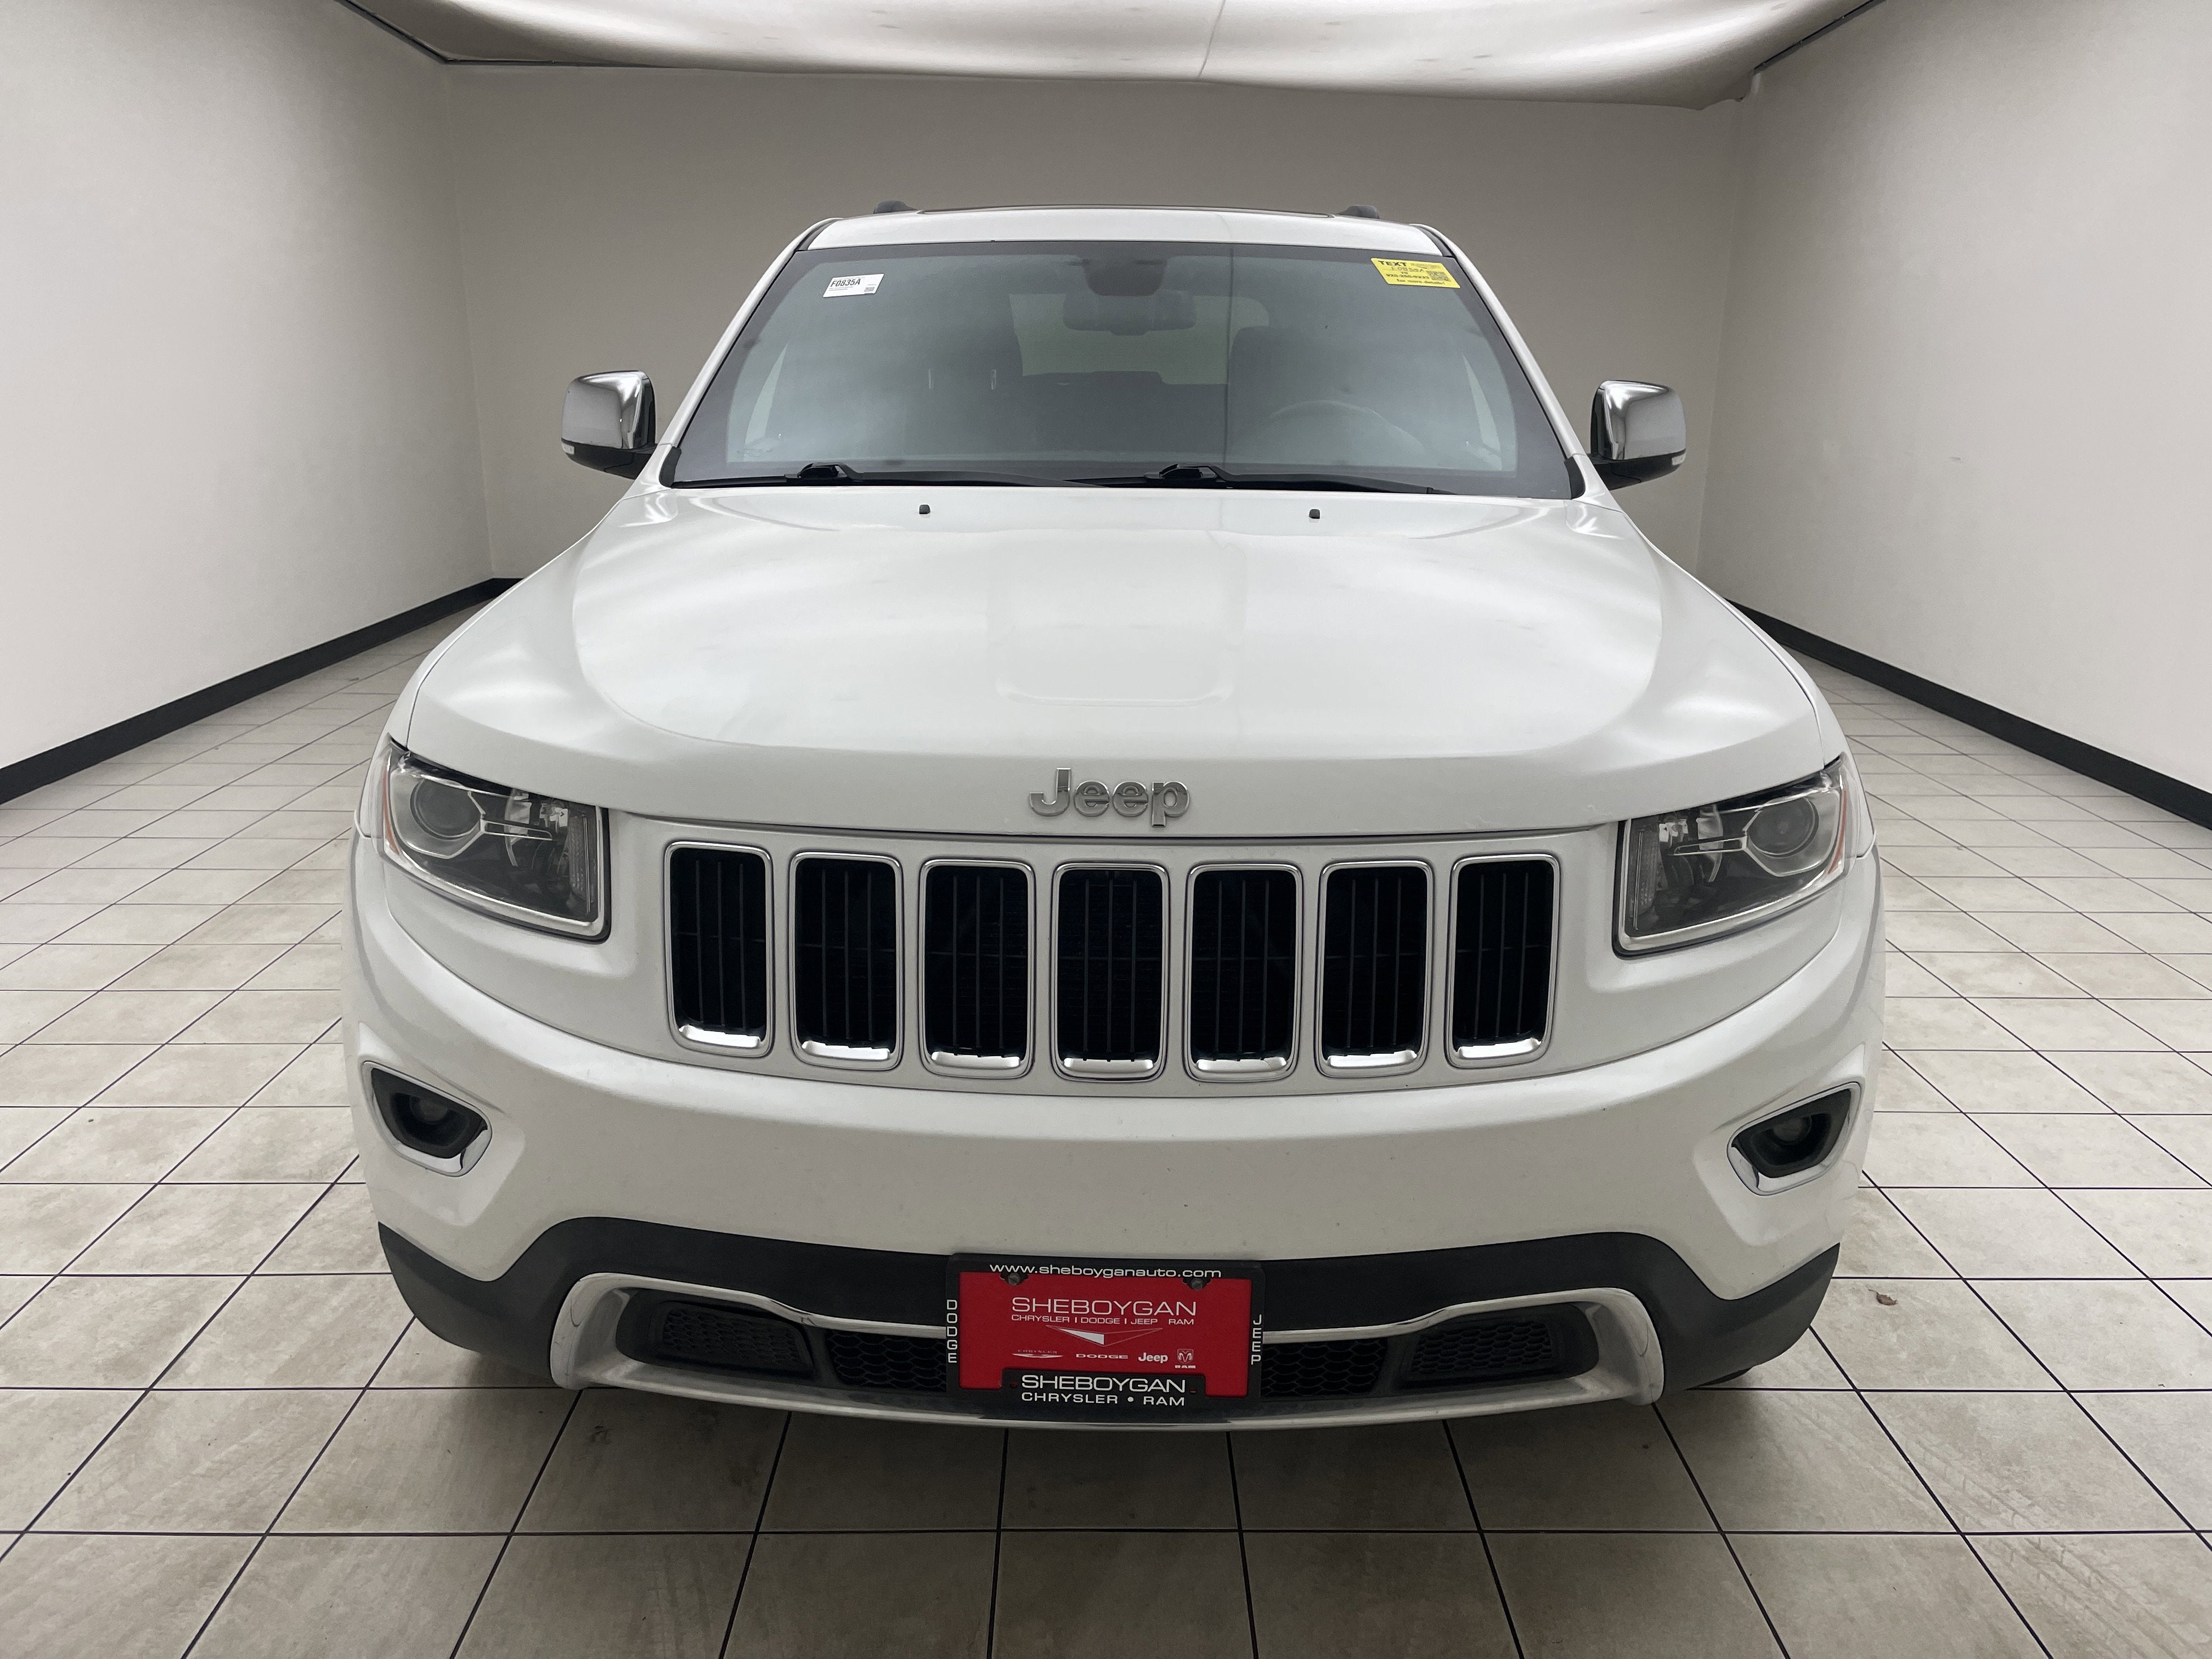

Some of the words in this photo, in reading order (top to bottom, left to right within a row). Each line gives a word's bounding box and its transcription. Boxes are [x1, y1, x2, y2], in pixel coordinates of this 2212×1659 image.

[830, 279, 861, 287] F0835A
[1029, 767, 1190, 828] Jeep
[989, 1263, 1222, 1278] www.sheboyganauto.com
[1012, 1296, 1197, 1316] SHEBOYGAN
[1011, 1314, 1070, 1323] CHRYSLER
[1080, 1317, 1120, 1325] DODGE
[1131, 1318, 1158, 1326] JEEP
[946, 1299, 958, 1364] DODGE
[1250, 1314, 1262, 1365] JEEP
[1138, 1352, 1169, 1364] Jeep
[1022, 1375, 1186, 1393] SHEBOYGAN
[1022, 1392, 1118, 1404] CHRYSLER
[1143, 1396, 1185, 1407] RAM
